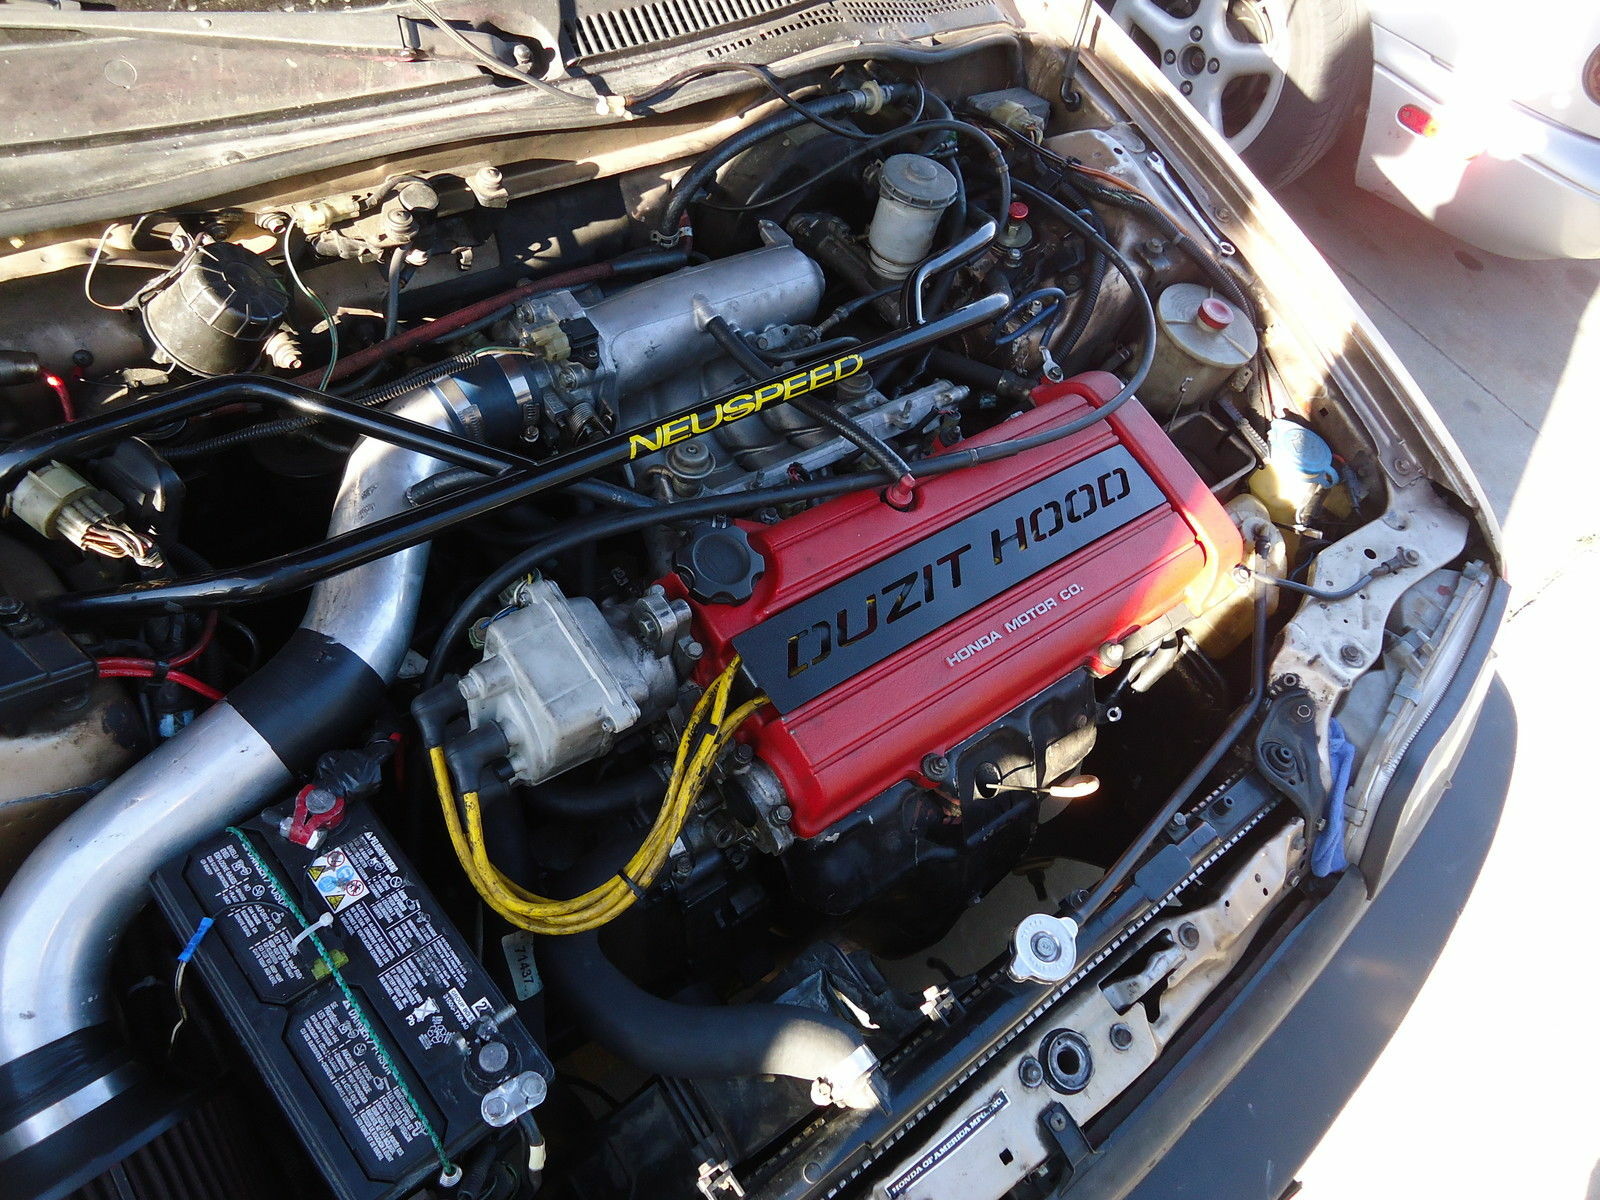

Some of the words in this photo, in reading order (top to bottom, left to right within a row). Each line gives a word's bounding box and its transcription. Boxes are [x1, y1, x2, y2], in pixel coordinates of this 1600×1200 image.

[630, 354, 863, 459] NEUSPEED
[787, 543, 971, 678] DUZIT
[990, 467, 1131, 565] HOOD
[945, 630, 1002, 667] HONDA
[1004, 597, 1057, 633] MOTOR
[1059, 583, 1084, 601] CO.
[404, 1014, 416, 1026] Pb
[450, 989, 465, 1008] GROUP
[892, 1166, 923, 1194] HONDA
[934, 1126, 972, 1160] AMERICA
